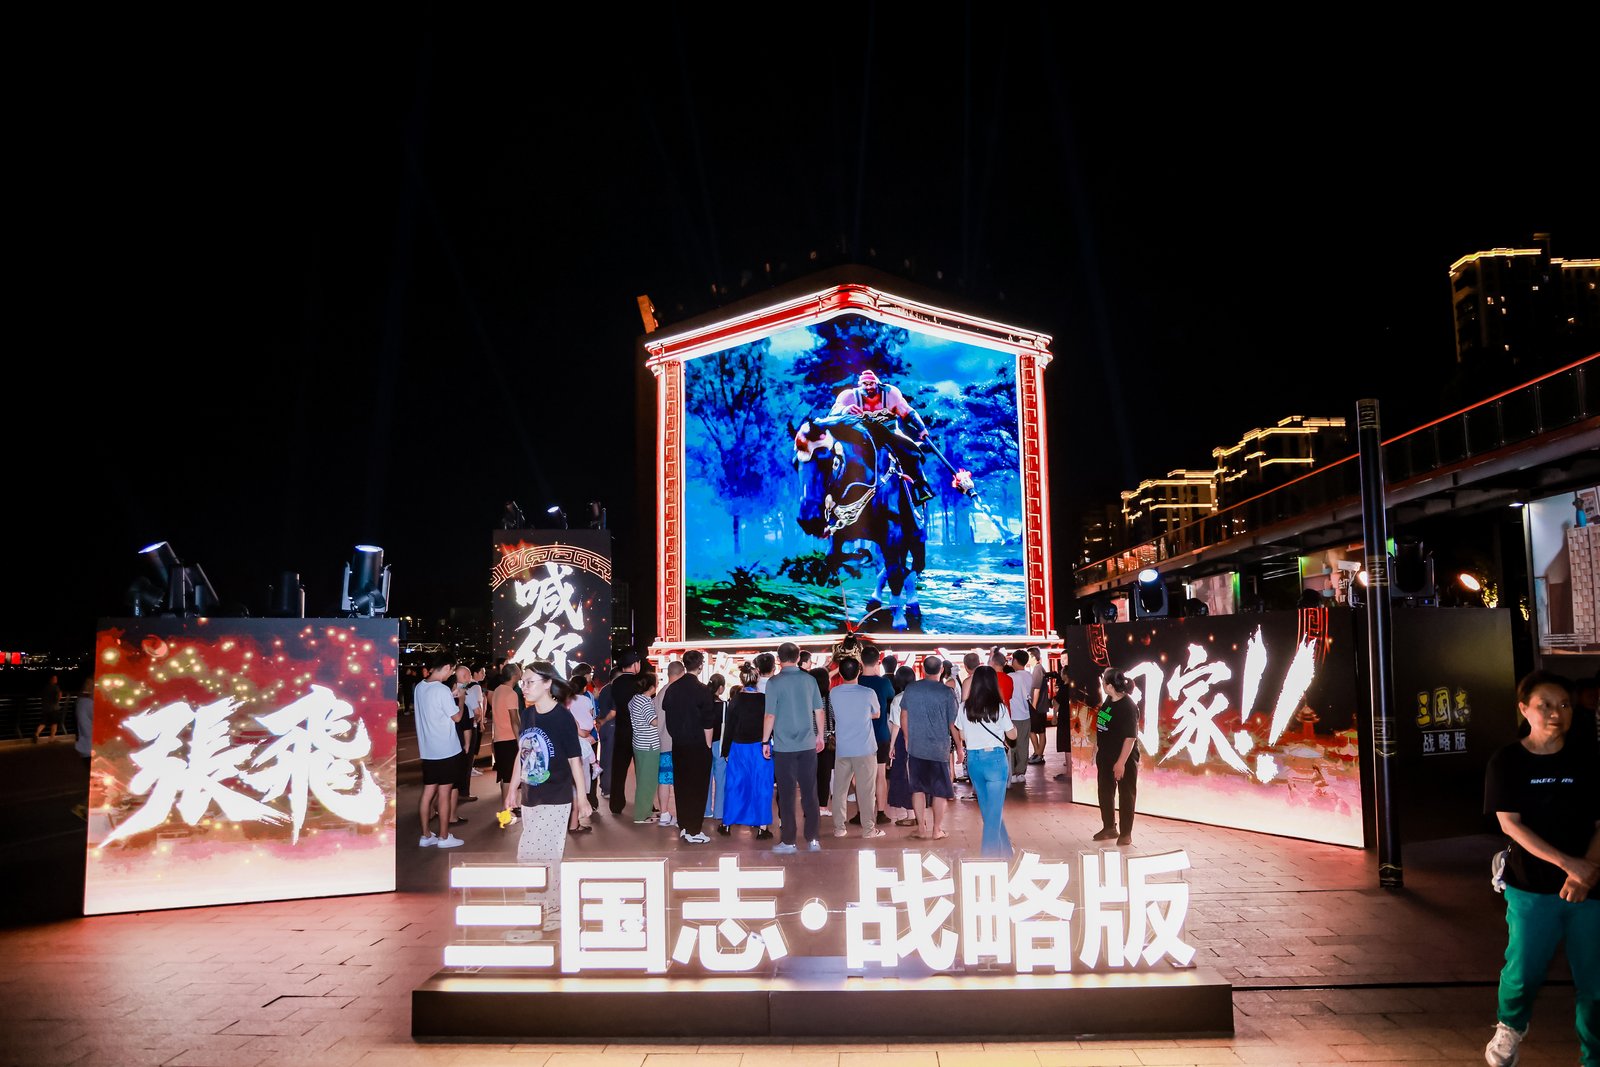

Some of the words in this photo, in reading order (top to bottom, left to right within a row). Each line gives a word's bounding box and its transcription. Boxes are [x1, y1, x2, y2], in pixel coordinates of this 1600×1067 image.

[508, 561, 586, 681] 喊你
[98, 684, 387, 848] 張飛
[1423, 731, 1467, 753] 战略版
